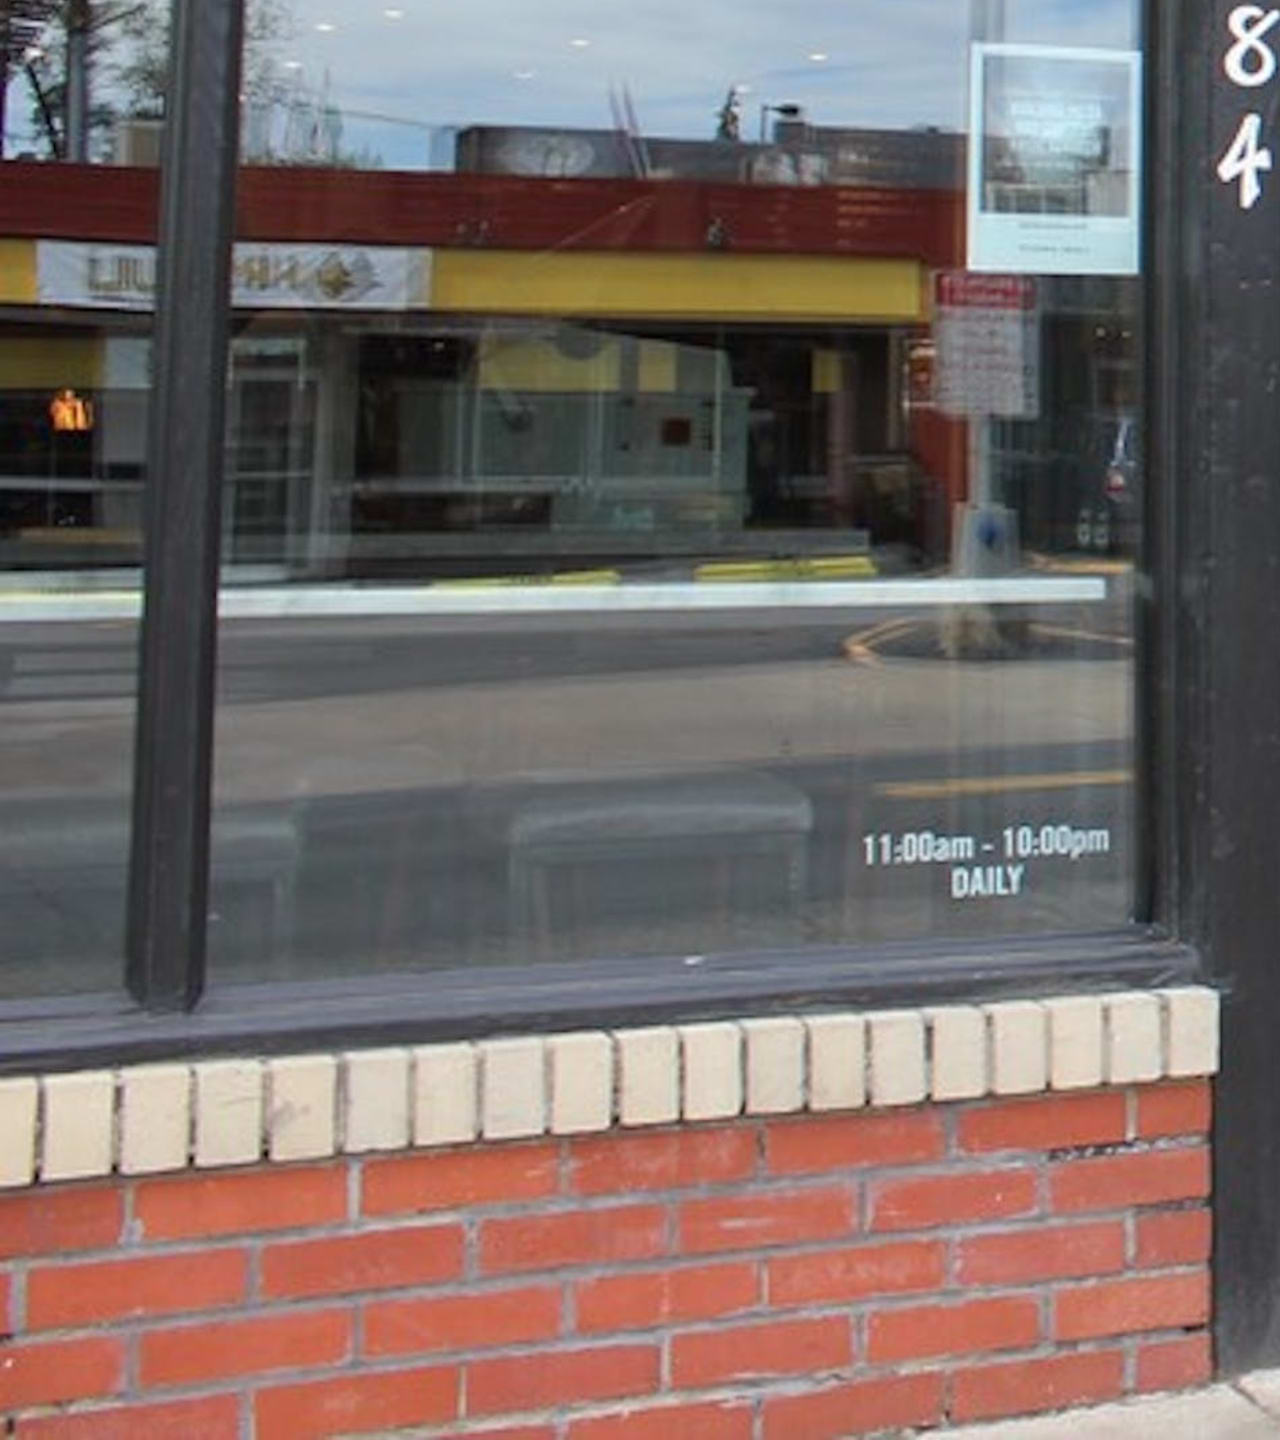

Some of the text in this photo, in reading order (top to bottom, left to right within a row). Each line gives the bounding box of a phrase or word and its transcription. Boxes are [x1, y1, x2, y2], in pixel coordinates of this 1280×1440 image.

[863, 830, 976, 866] 11:00am
[1003, 824, 1110, 860] 10:00pm
[951, 864, 1024, 899] DAILY
